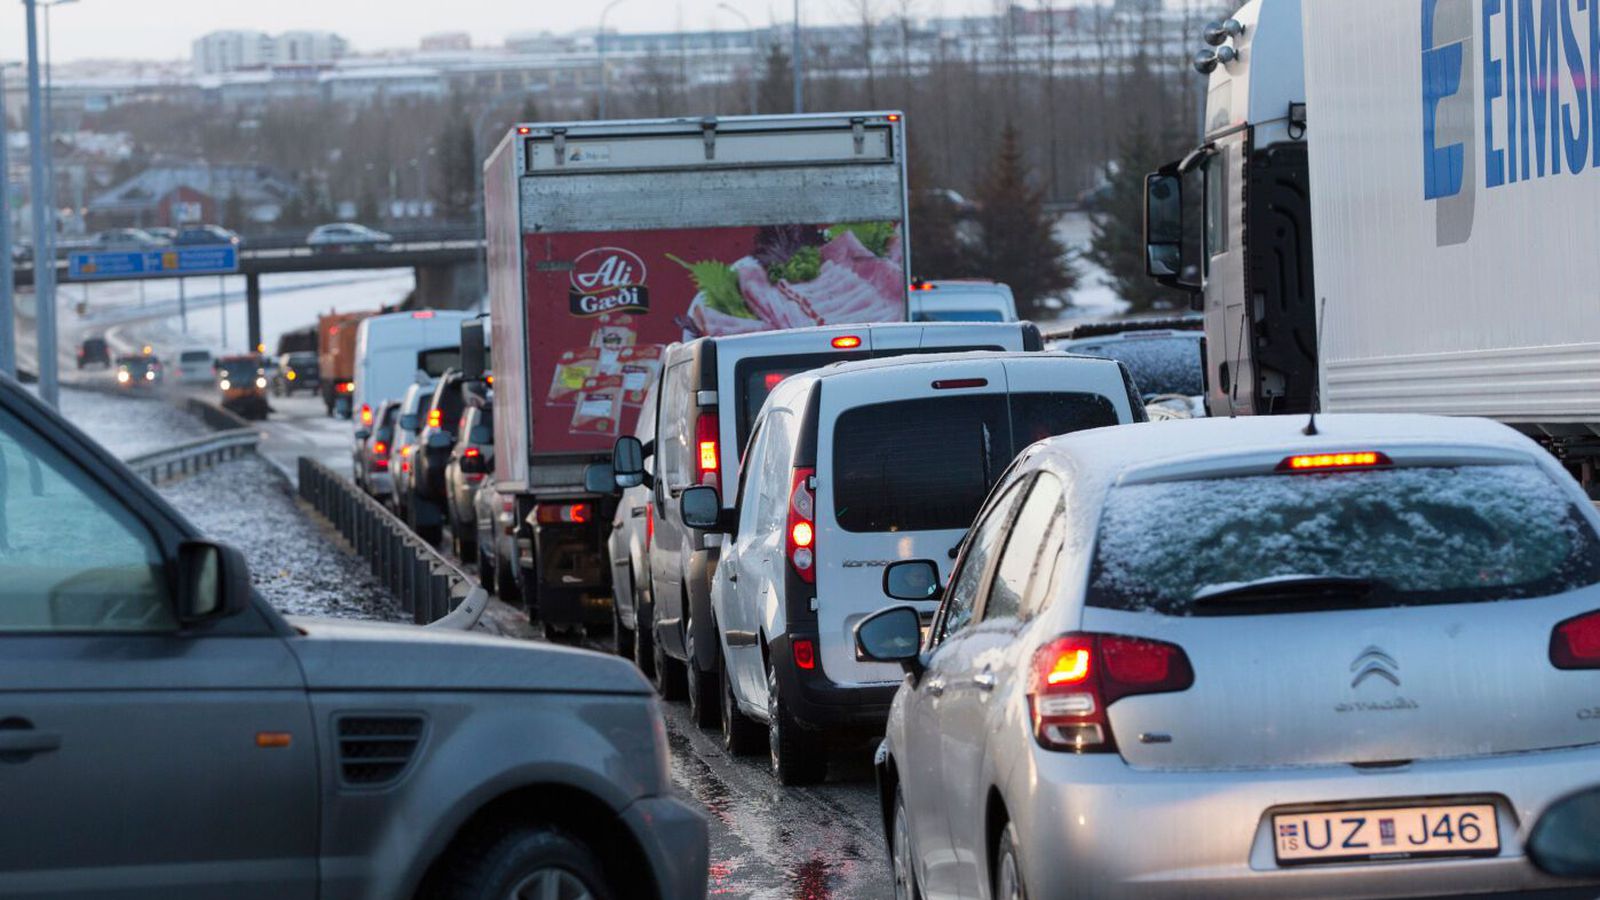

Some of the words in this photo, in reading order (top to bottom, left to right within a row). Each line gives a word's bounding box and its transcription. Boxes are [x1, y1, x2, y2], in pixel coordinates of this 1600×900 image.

[577, 255, 632, 288] Ali
[580, 287, 640, 313] Gæði
[1281, 838, 1300, 851] IS
[1302, 817, 1370, 851] UZ
[1407, 812, 1482, 846] J46
